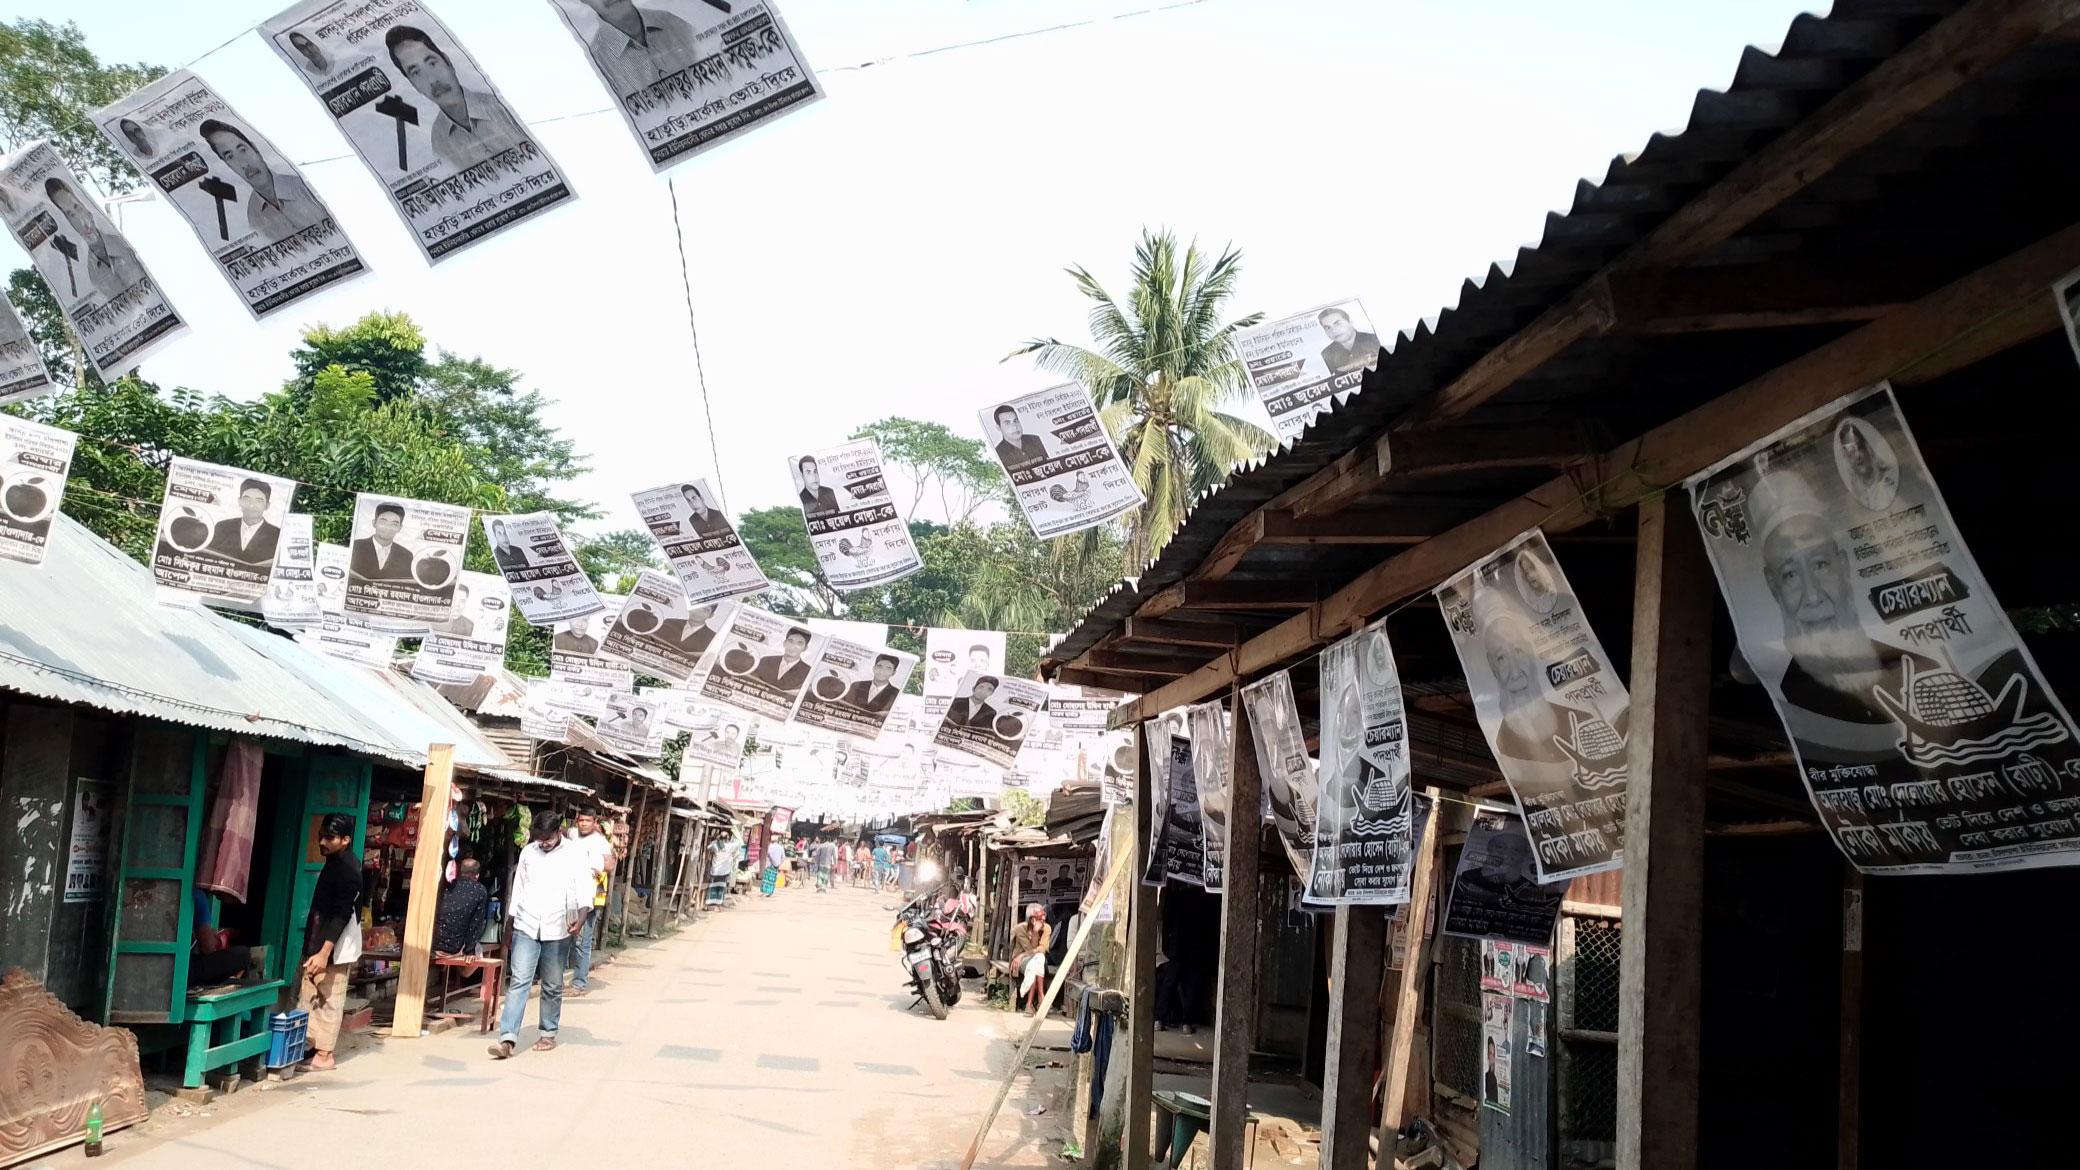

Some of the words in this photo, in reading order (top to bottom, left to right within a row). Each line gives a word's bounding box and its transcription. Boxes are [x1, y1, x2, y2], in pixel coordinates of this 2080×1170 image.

[688, 53, 730, 87] রহমান
[645, 116, 685, 140] হাতুড়ি
[686, 99, 726, 122] মার্কায়
[729, 82, 761, 106] ভোট
[761, 67, 797, 91] দিয়ে
[458, 159, 500, 187] রহমান
[422, 215, 459, 239] হাতুড়ি
[460, 199, 497, 220] মার্কায়
[500, 182, 526, 203] ভোট
[526, 171, 555, 190] দিয়ে
[246, 277, 279, 298] হাতুড়ি
[309, 254, 331, 271] ভোট
[1268, 397, 1292, 412] মোঃ
[1294, 382, 1331, 404] জুয়েল
[1012, 470, 1032, 482] মোঃ
[1032, 459, 1063, 478] জুয়েল
[1065, 449, 1110, 468] মোল্লা-কে
[1021, 486, 1049, 498] মোরগ
[1088, 464, 1119, 479] মার্কায়
[1028, 501, 1048, 513] ভোট
[1103, 478, 1126, 490] দিয়ে
[809, 520, 825, 532] মোঃ
[825, 512, 851, 530] জুয়েল
[853, 505, 895, 525] মোল্লা-কে
[155, 569, 189, 583] আপেল
[202, 564, 225, 576] রহমান
[1879, 572, 1955, 613] চেয়ারম্যান
[1899, 607, 1973, 645] পদপ্রার্থী
[1551, 654, 1593, 685] চেয়ারম্যান
[1564, 677, 1608, 703] পদপ্রার্থী
[1809, 767, 1826, 782] বীর
[1830, 764, 1877, 783] মুক্তিযোদ্ধা
[1864, 784, 1890, 810] মোঃ
[1891, 780, 1949, 808] দেলোয়ার
[1947, 772, 2004, 801] হোসেন
[1961, 810, 1996, 828] দিয়ে
[1998, 804, 2027, 823] দেশ
[2032, 802, 2043, 815] ও
[1540, 831, 1575, 865] নৌকা
[1569, 820, 1608, 857] মার্কায়
[1836, 815, 1888, 855] নৌকা
[1877, 810, 1941, 852] মার্কায়
[1959, 832, 1991, 847] সেবা
[1991, 826, 2028, 841] করার
[2029, 819, 2076, 839] সুযোগ
[1364, 841, 1384, 858] হোসেন
[1362, 863, 1373, 874] দিয়ে
